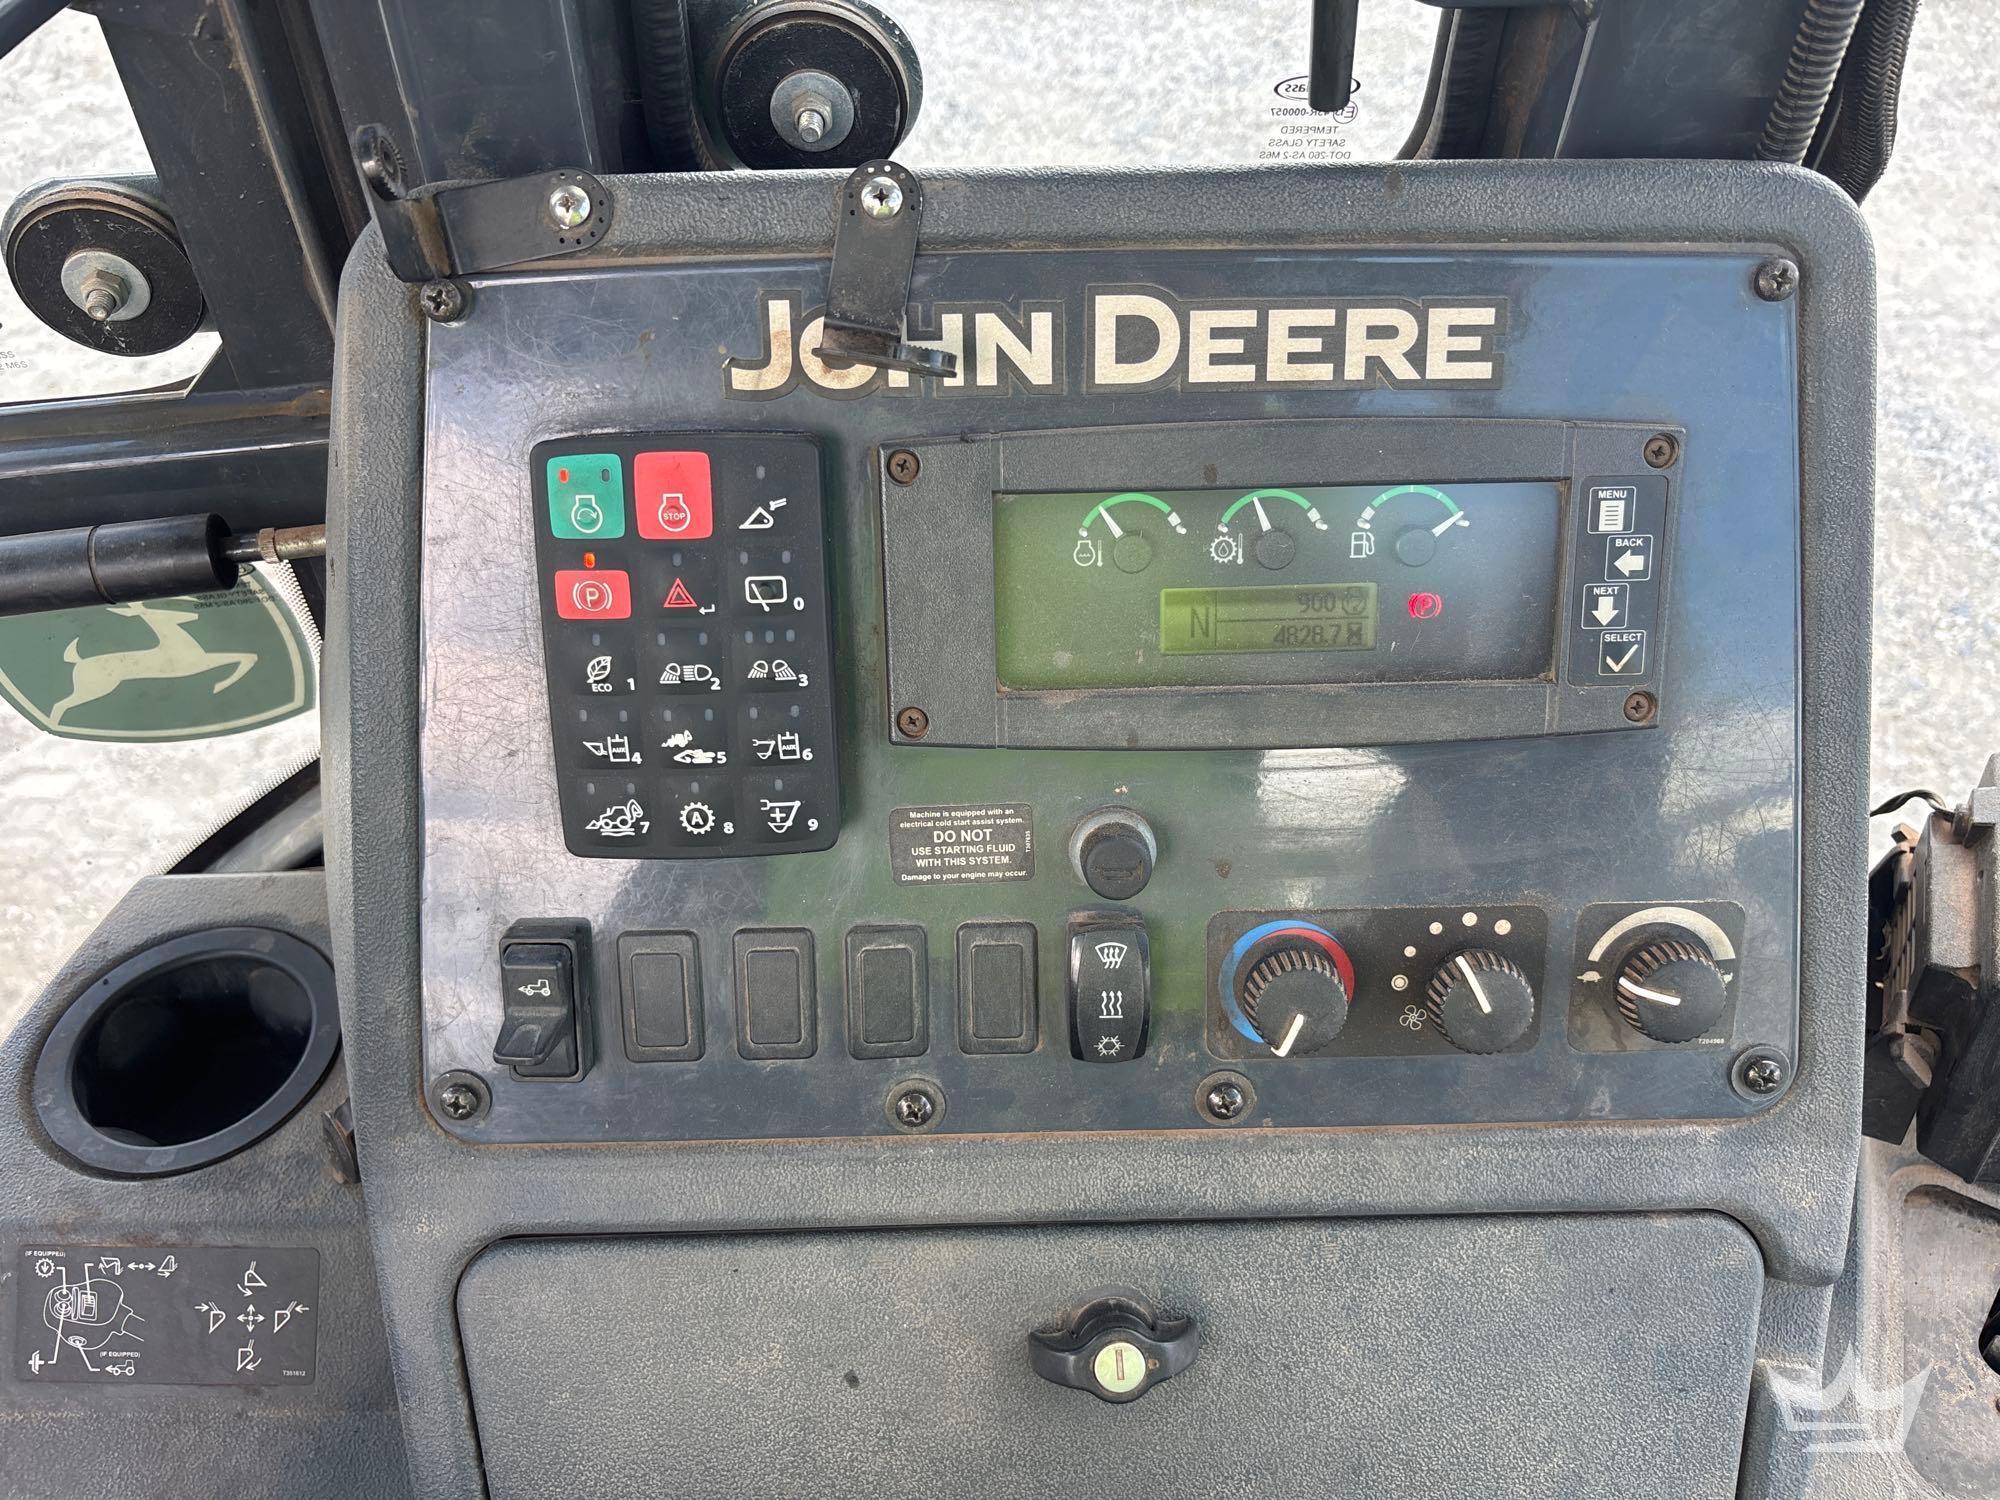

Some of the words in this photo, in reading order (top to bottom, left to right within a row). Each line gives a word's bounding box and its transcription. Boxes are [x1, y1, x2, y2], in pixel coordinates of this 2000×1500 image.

[1095, 294, 1496, 386] DEERE
[1598, 490, 1627, 499] MENU
[663, 511, 687, 521] STOP
[1615, 538, 1643, 547] BACK
[1593, 587, 1620, 595] NEXT
[793, 597, 805, 610] 0
[1298, 592, 1337, 613] 900
[1190, 606, 1209, 638] N
[1273, 624, 1342, 646] 4828.7
[1604, 633, 1642, 642] SELECT
[627, 678, 636, 691] 1
[710, 678, 722, 691] 2
[798, 674, 809, 687] 3
[592, 683, 613, 693] ECO
[631, 752, 642, 765] 4
[716, 752, 727, 765] 5
[802, 749, 813, 761] 6
[691, 811, 704, 825] A
[909, 811, 941, 819] Machine
[951, 809, 986, 818] equipped
[808, 819, 819, 831] 9
[996, 817, 1024, 825] system.
[640, 822, 650, 834] 7
[723, 822, 734, 834] 8
[933, 830, 956, 843] DO
[961, 829, 993, 842] NOT
[911, 847, 932, 856] USE
[934, 844, 984, 855] STARTING
[986, 844, 1016, 853] FLUID
[916, 858, 941, 867] WITH
[944, 857, 967, 866] THIS
[968, 856, 1012, 865] SYSTEM.
[901, 873, 932, 882] Damage
[942, 873, 959, 881] your
[961, 871, 986, 880] engine
[987, 871, 1003, 879] may
